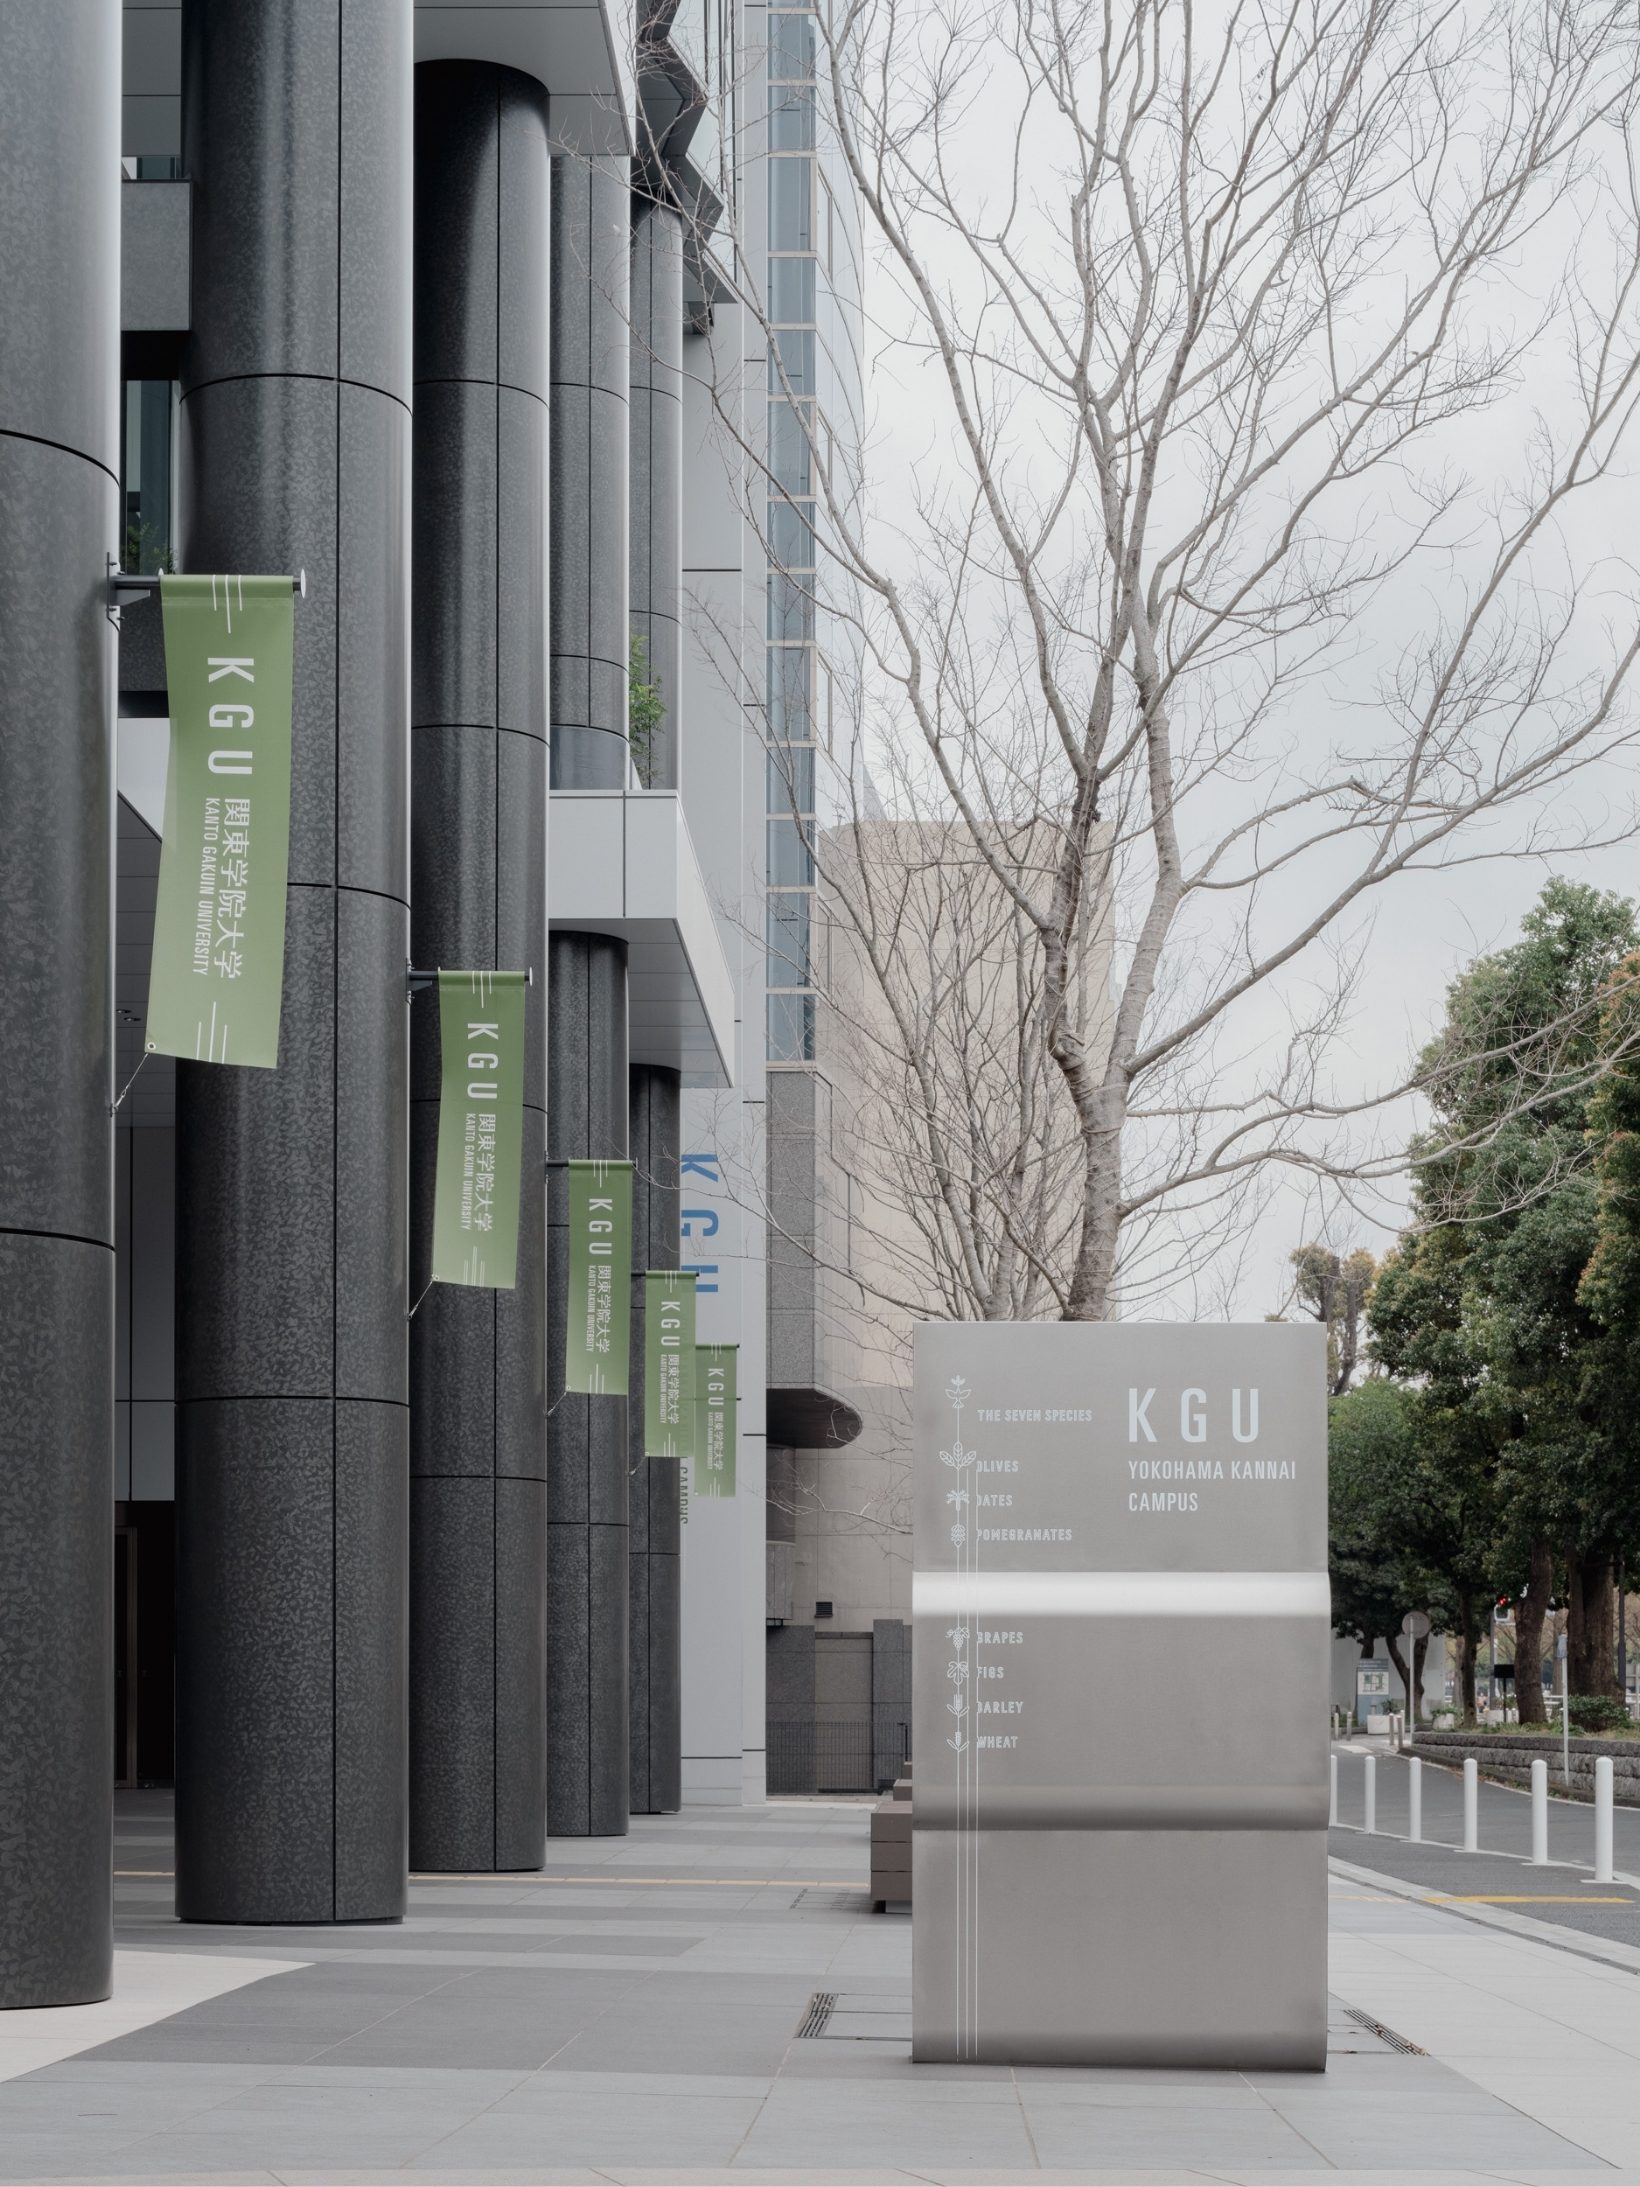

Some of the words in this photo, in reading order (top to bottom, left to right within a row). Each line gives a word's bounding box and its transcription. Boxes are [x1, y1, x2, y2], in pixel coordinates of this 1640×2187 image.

[207, 657, 255, 775] KGU
[203, 797, 220, 841] KANTO
[199, 845, 218, 895] GAKUIN
[214, 798, 251, 979] 関東学院大学
[192, 899, 213, 976] UNIVERSITY
[467, 1023, 499, 1099] KGU
[464, 1112, 476, 1142] KANTO
[463, 1144, 475, 1177] GAKUIN
[474, 1113, 497, 1232] 関東学院大学
[460, 1180, 474, 1231] UNIVERSITY
[588, 1198, 613, 1255] KGU
[595, 1265, 612, 1353] 関東学院大学
[660, 1301, 681, 1347] KGU
[707, 1368, 724, 1406] KGU
[977, 1409, 1001, 1422] THE
[1004, 1409, 1041, 1422] SEVEN
[1045, 1409, 1093, 1422] SPECIES
[1128, 1387, 1259, 1443] KGU
[1128, 1460, 1224, 1480] YOKOHAMA
[1231, 1460, 1296, 1480] KANNAI
[1128, 1492, 1199, 1512] CAMPUS
